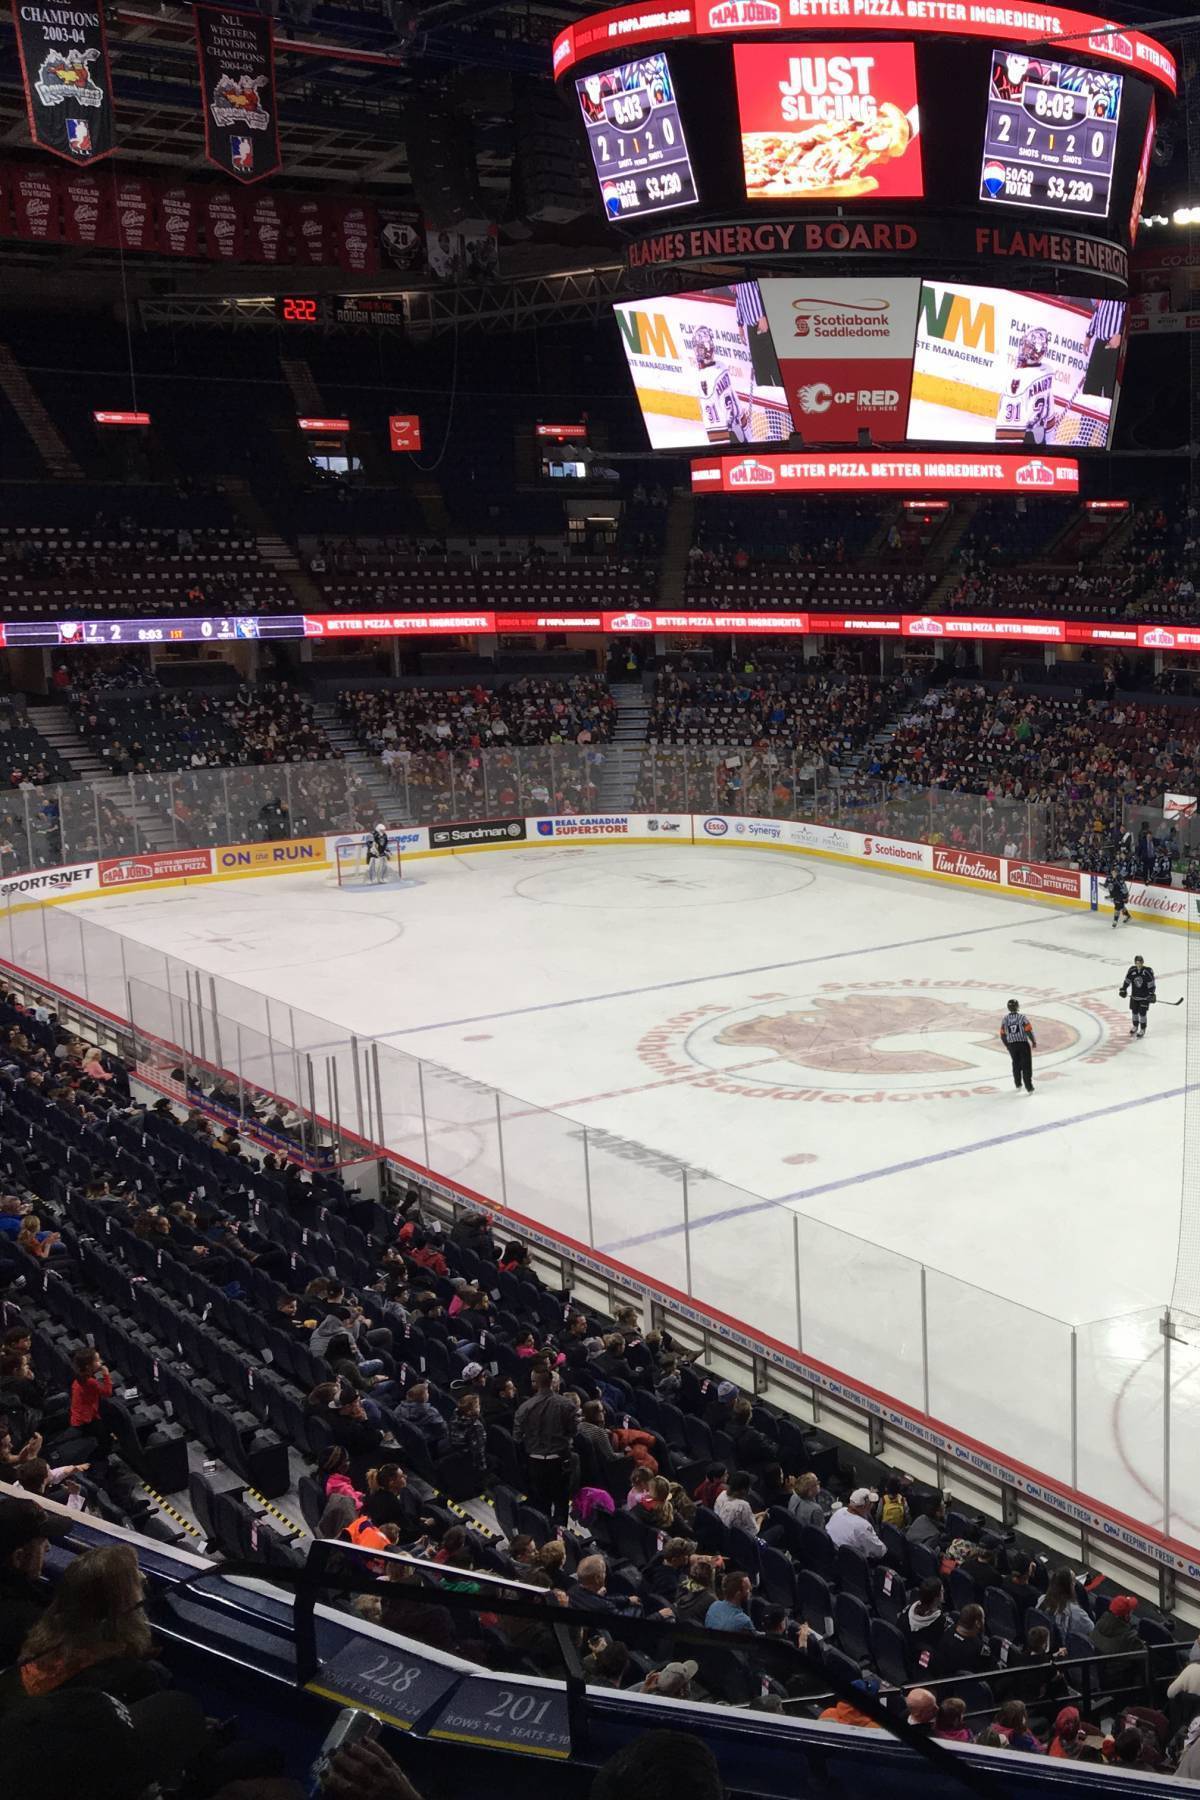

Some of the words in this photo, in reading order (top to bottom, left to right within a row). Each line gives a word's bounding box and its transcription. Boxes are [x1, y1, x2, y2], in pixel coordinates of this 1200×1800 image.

[20, 6, 100, 28] CHAMPIONS
[220, 14, 244, 27] NLL
[789, 0, 851, 16] BETTER
[854, 0, 905, 16] PIZZA.
[907, 0, 967, 20] BETTER
[970, 5, 1064, 34] INGREDIENTS.
[42, 26, 86, 45] 2003-04
[209, 24, 257, 40] WESTERN
[212, 36, 258, 51] DIVISION
[205, 46, 265, 63] CHAMPIONS
[778, 56, 875, 97] JUST
[612, 94, 644, 125] 8:03
[781, 95, 877, 121] SLICING
[1034, 90, 1075, 121] 8:03
[597, 135, 611, 162] 2
[645, 131, 655, 150] 2
[661, 117, 676, 146] 0
[996, 114, 1012, 142] 2
[1026, 127, 1037, 146] 7
[1065, 135, 1076, 153] 2
[1090, 131, 1105, 158] 0
[1018, 147, 1040, 159] SHOTS
[1062, 155, 1083, 165] SHOTS
[1005, 166, 1035, 183] 50/50
[645, 171, 682, 201] $3,230
[1005, 180, 1033, 198] TOTAL
[1047, 175, 1094, 202] $3,230
[628, 231, 687, 269] FLAMES
[690, 223, 795, 256] ENERGY
[804, 223, 918, 252] BOARD
[975, 227, 1072, 260] FLAMES
[1075, 239, 1124, 276] ENERGY
[337, 309, 368, 325] ROUGH
[813, 314, 889, 326] Scotiabank
[814, 327, 891, 338] Saddledome
[932, 344, 995, 369] MANAGEMENT
[834, 392, 855, 404] OF
[857, 389, 900, 407] RED
[1004, 403, 1021, 422] 31
[779, 464, 827, 478] BETTER
[829, 464, 869, 478] PIZZA.
[871, 463, 920, 478] BETTER
[924, 463, 1005, 479] INGREDIENTS.
[110, 624, 121, 640] 2
[201, 622, 213, 637] 0
[451, 825, 507, 842] Sandman
[555, 819, 577, 828] REAL
[579, 818, 629, 827] CANADIAN
[555, 825, 629, 836] SUPERSTORE
[748, 823, 781, 839] Synergy
[221, 851, 251, 867] ON
[874, 842, 924, 863] Scotiabank
[154, 864, 183, 874] BETTER
[933, 851, 955, 873] Tim
[955, 857, 998, 881] Hortons
[0, 867, 95, 898] SPORTSNET
[1124, 890, 1187, 914] udweiser
[819, 977, 1063, 998] Scotiabank
[690, 1074, 1000, 1103] Saddledome
[359, 1654, 423, 1693] 228
[484, 1690, 554, 1725] 201
[444, 1714, 481, 1730] ROWS
[511, 1726, 545, 1740] SEATS
